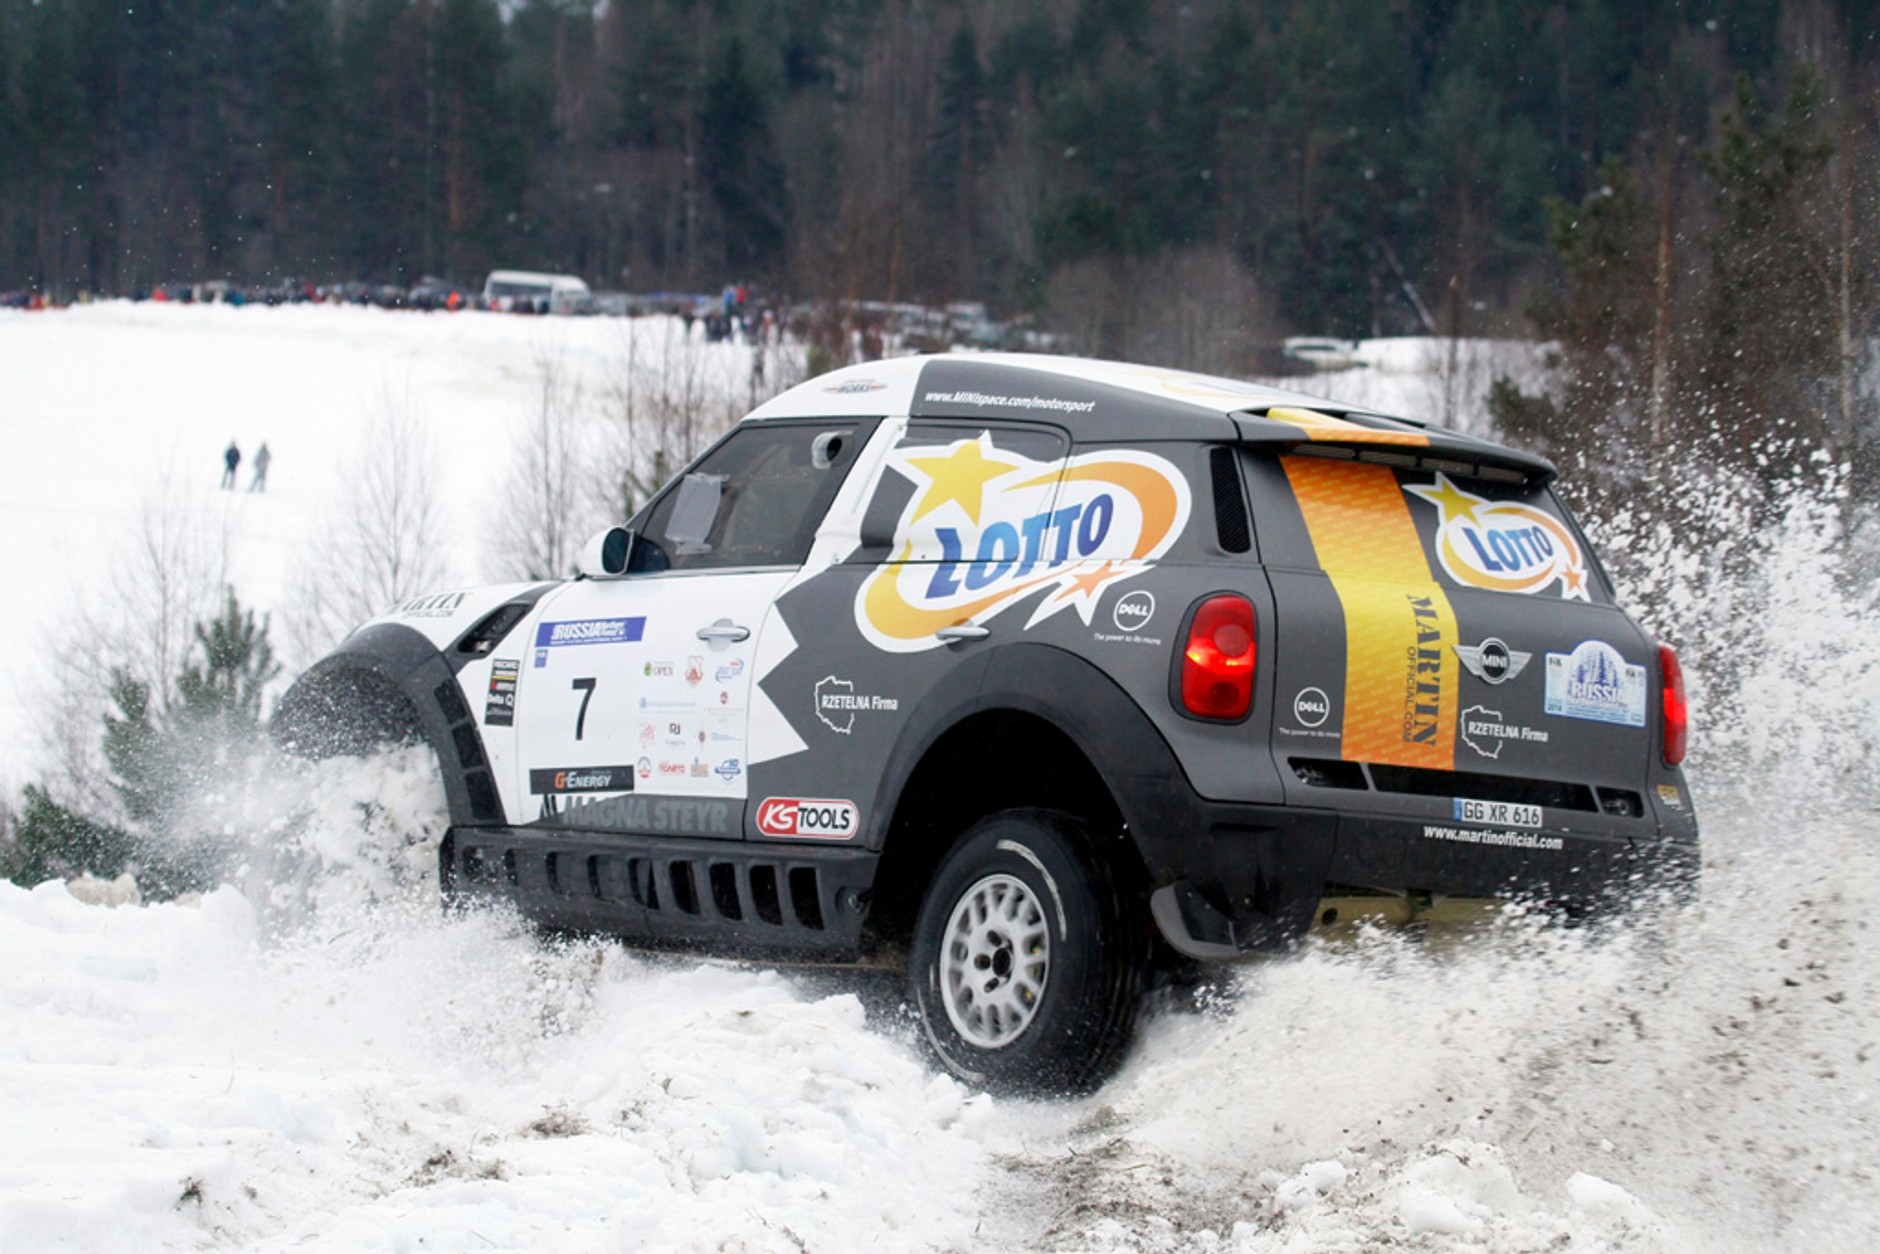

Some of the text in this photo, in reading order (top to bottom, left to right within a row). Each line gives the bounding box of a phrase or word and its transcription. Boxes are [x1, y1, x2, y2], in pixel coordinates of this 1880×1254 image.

[925, 391, 1096, 413] www.MINIspace.com/motorsport
[924, 493, 1114, 600] LOTTO
[1461, 525, 1554, 572] LOTTO
[1118, 603, 1149, 616] DELL
[1406, 593, 1441, 747] MARTIN
[1482, 654, 1508, 668] MINI
[821, 694, 899, 711] RZETELNA Firma
[1402, 646, 1417, 743] OFFICIAL.COM
[1572, 682, 1627, 704] RUSSIA
[572, 678, 596, 740] 7
[1298, 701, 1325, 713] DELL
[1468, 721, 1549, 743] RZETELNA Firma
[561, 795, 728, 833] MAGNA STEYR
[763, 804, 850, 830] KS TOOLS
[1464, 802, 1540, 825] GG XR 616
[1423, 825, 1564, 850] www.martinofficial.com
